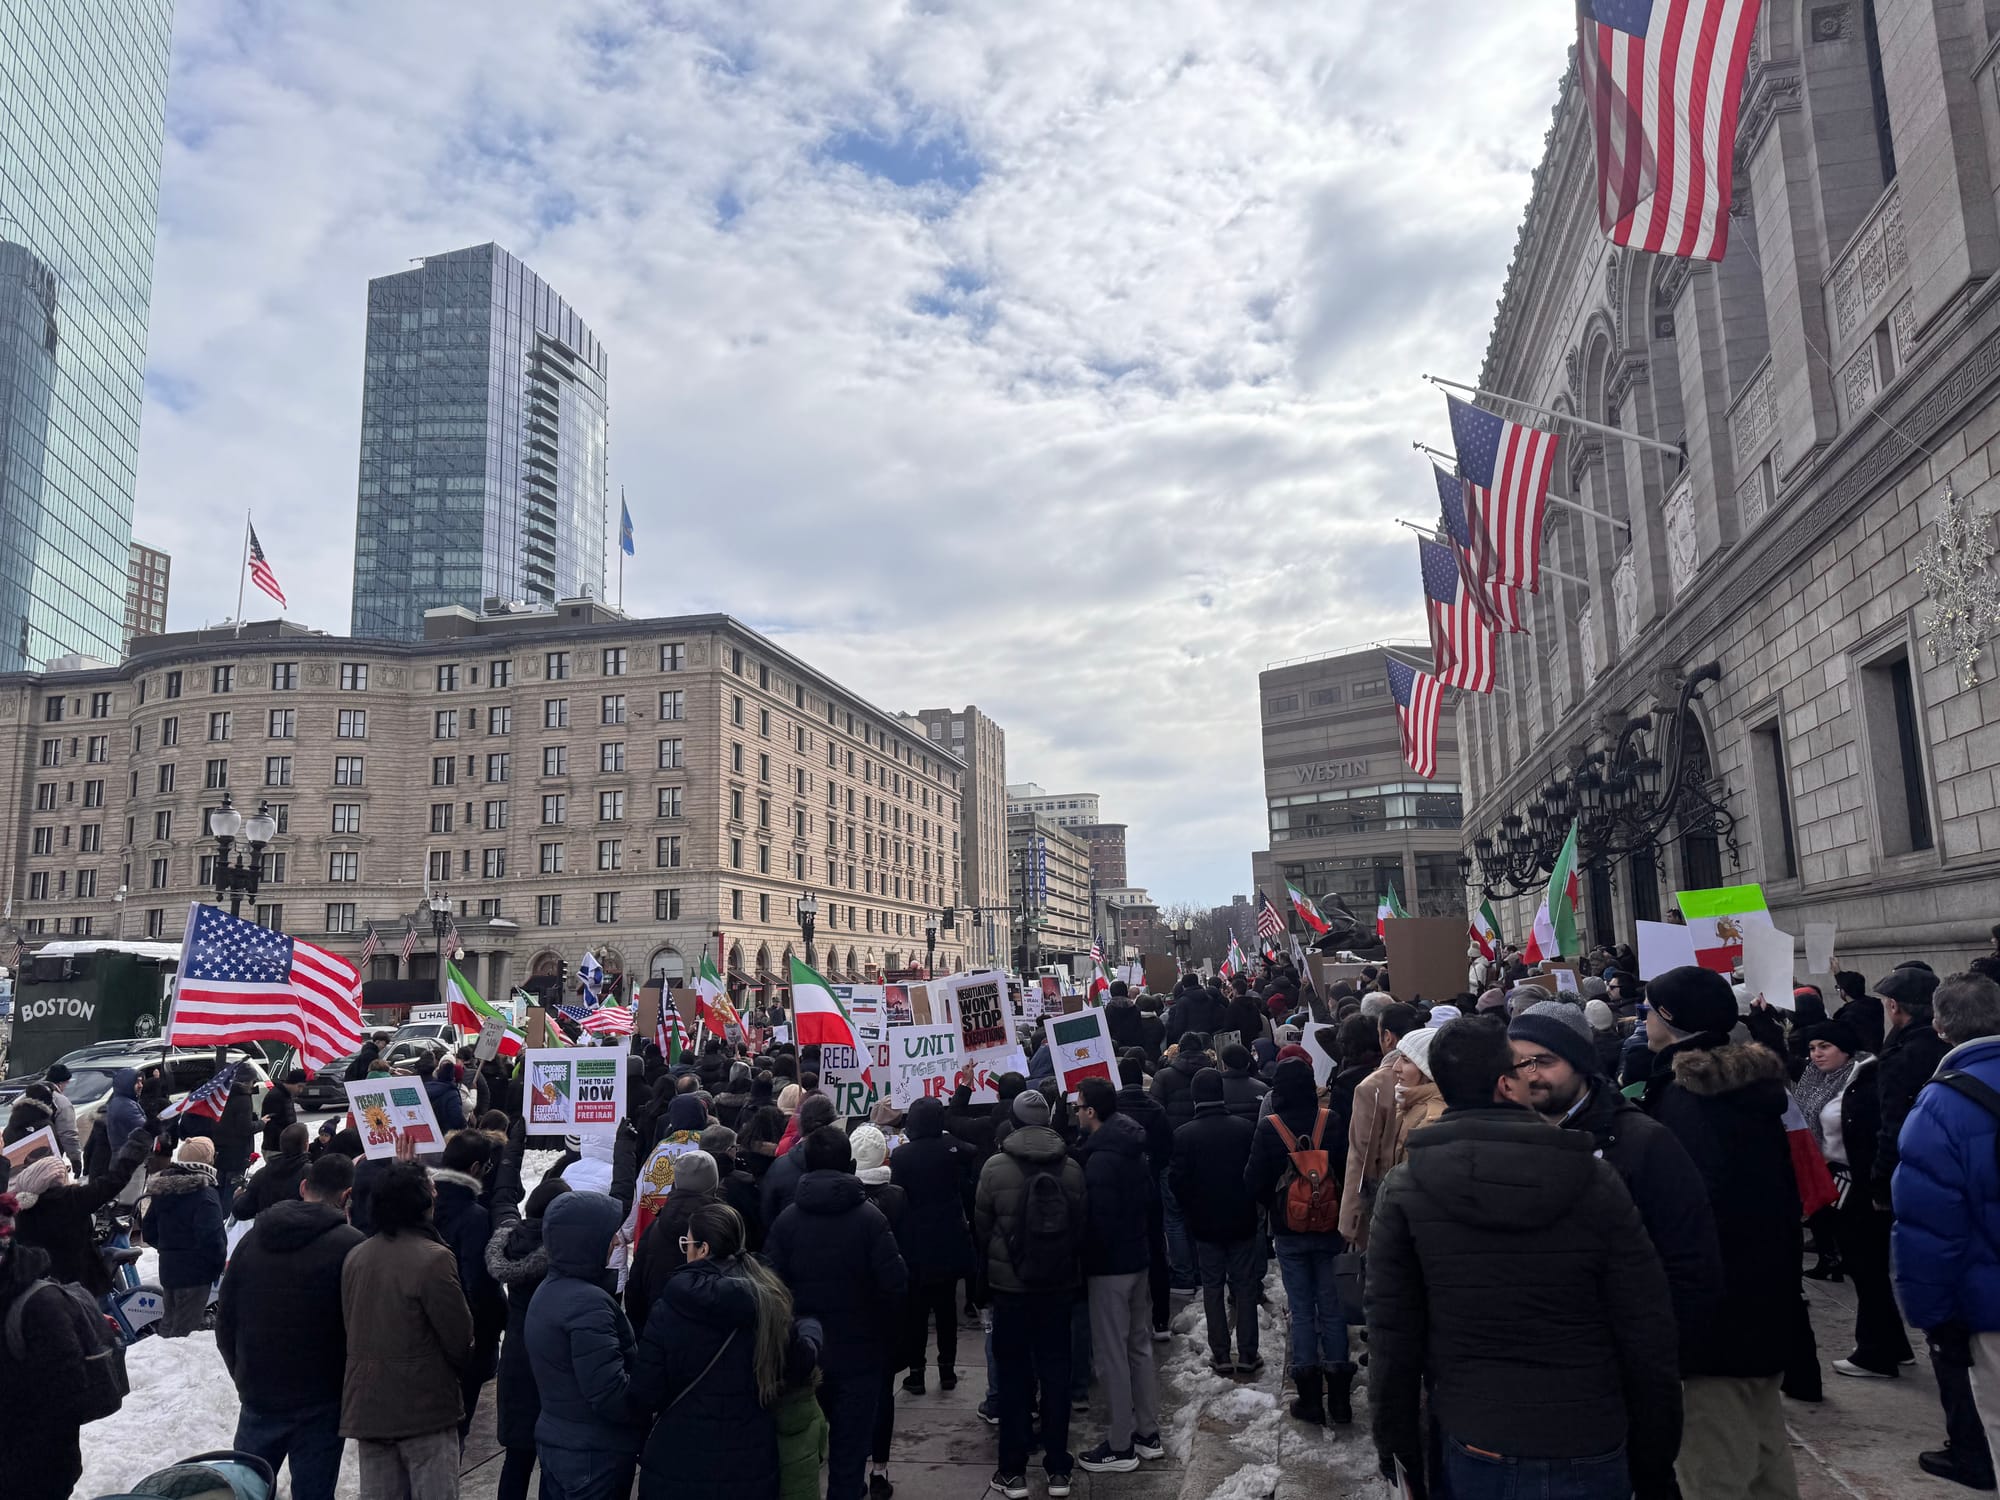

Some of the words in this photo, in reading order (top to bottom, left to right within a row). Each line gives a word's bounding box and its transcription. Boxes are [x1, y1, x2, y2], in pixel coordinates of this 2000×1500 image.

[1295, 760, 1369, 783] WESTIN
[958, 983, 998, 1000] NEGOTIATIONS
[21, 998, 95, 1022] BOSTON
[959, 995, 999, 1015] WON'T
[962, 1009, 1001, 1032] STOP
[904, 1033, 955, 1058] UNIT
[963, 1027, 1006, 1046] EXECUTIONS
[823, 1046, 874, 1068] REGIE
[578, 1085, 614, 1101] NOW
[595, 1111, 613, 1119] IRAN
